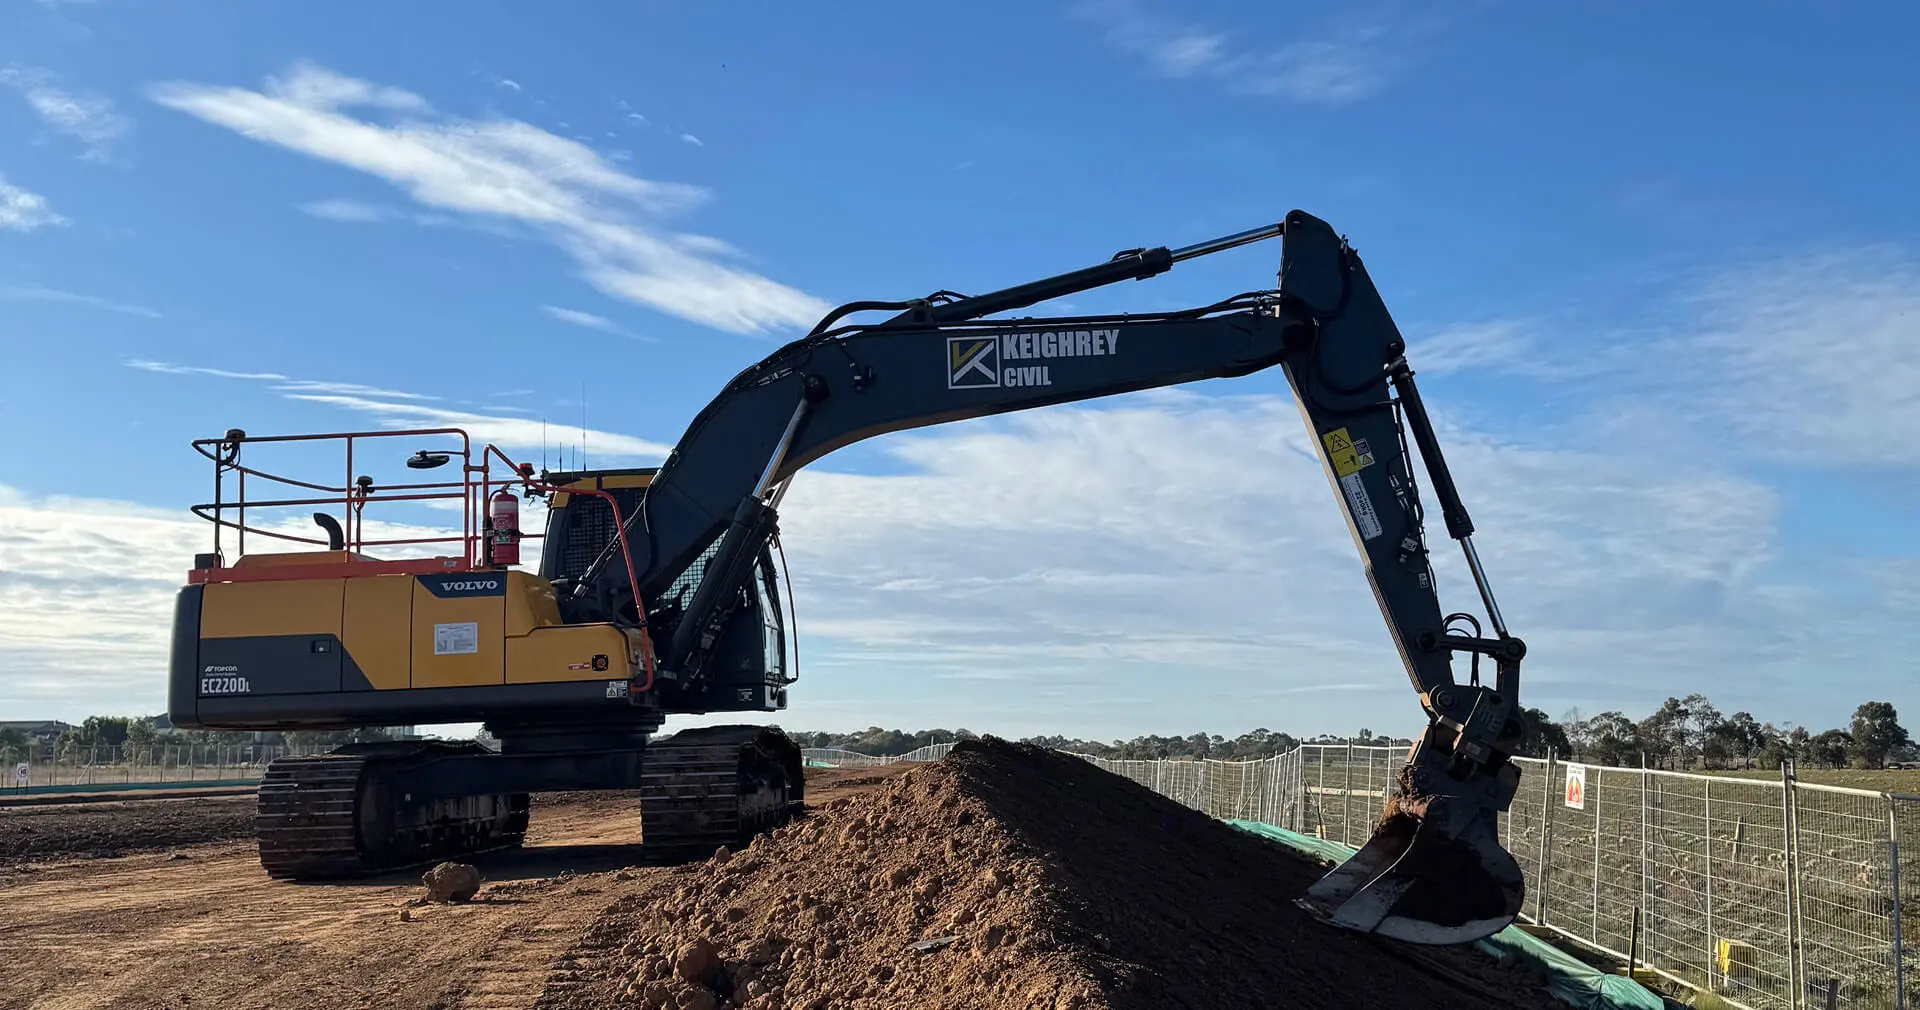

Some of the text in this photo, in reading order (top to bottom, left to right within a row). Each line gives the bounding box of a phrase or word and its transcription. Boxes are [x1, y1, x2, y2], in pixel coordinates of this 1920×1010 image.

[1002, 329, 1120, 360] KEIGHREY
[1004, 366, 1052, 388] CIVIL
[440, 580, 498, 592] VOLVO
